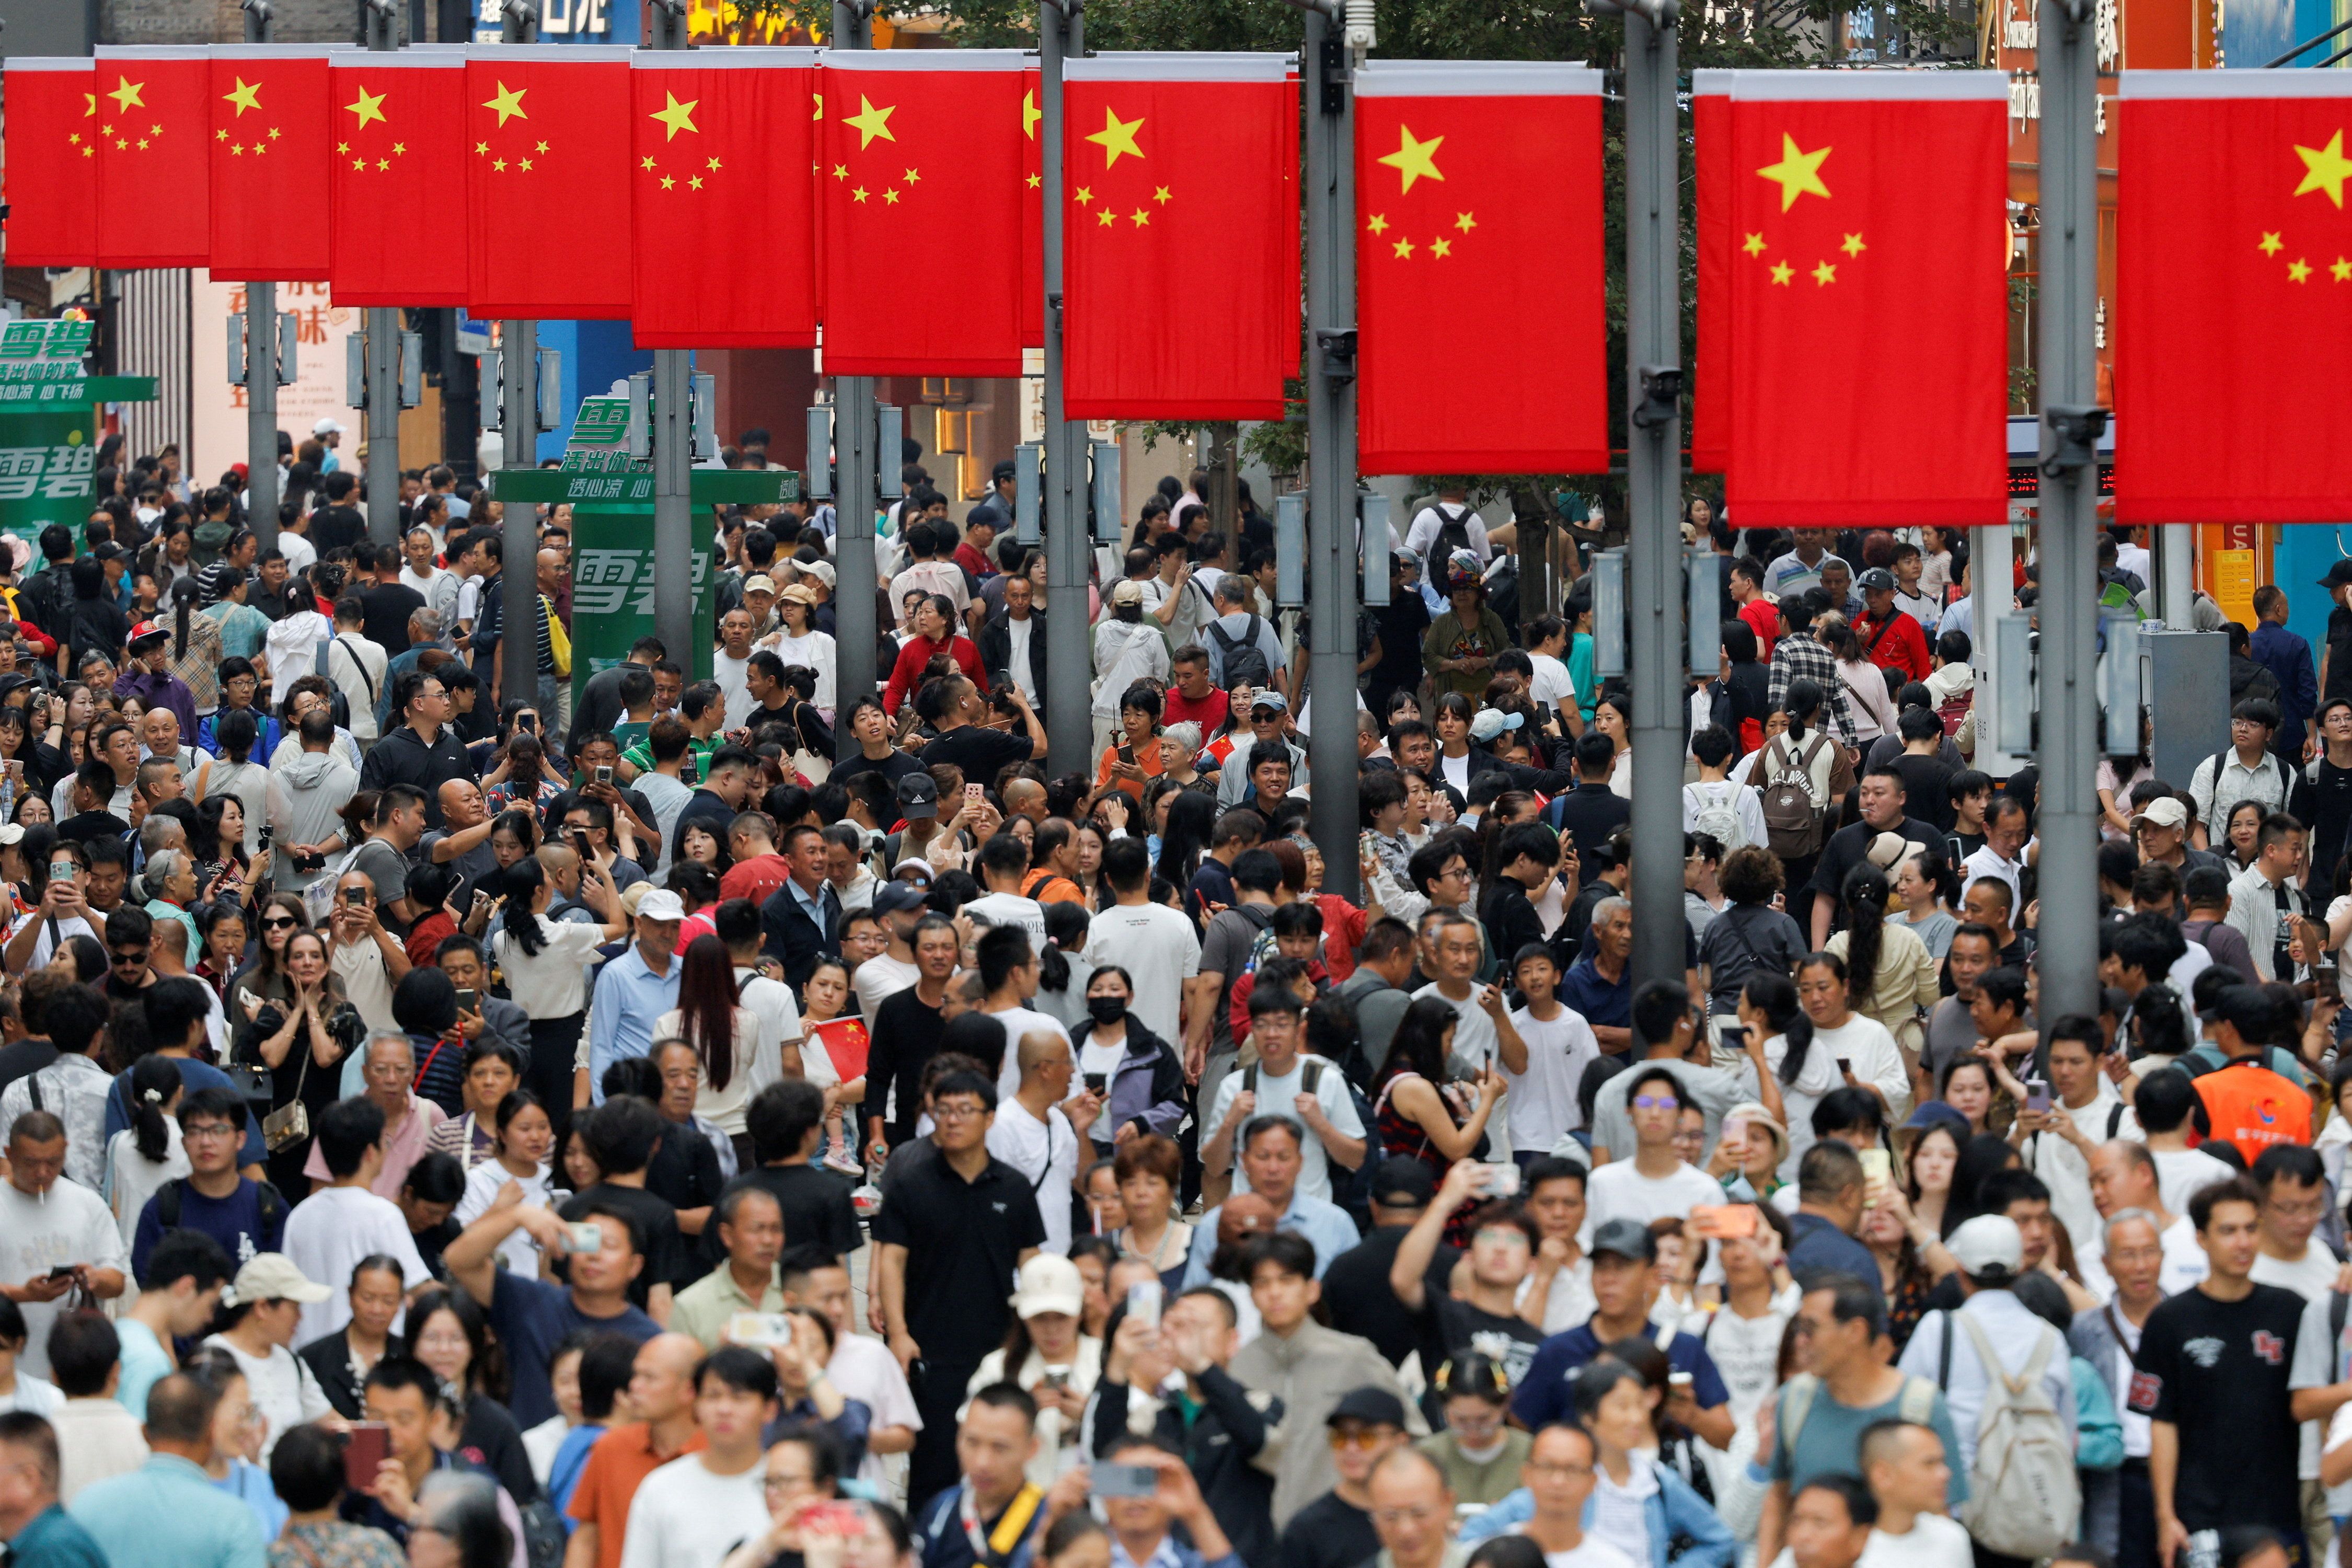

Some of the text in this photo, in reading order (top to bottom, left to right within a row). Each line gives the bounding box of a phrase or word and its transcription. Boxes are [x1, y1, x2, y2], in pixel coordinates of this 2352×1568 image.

[0, 321, 95, 358] 雪碧
[39, 383, 85, 400] 心飞扬
[0, 444, 95, 498] 雪碧
[568, 478, 624, 497] 透心凉
